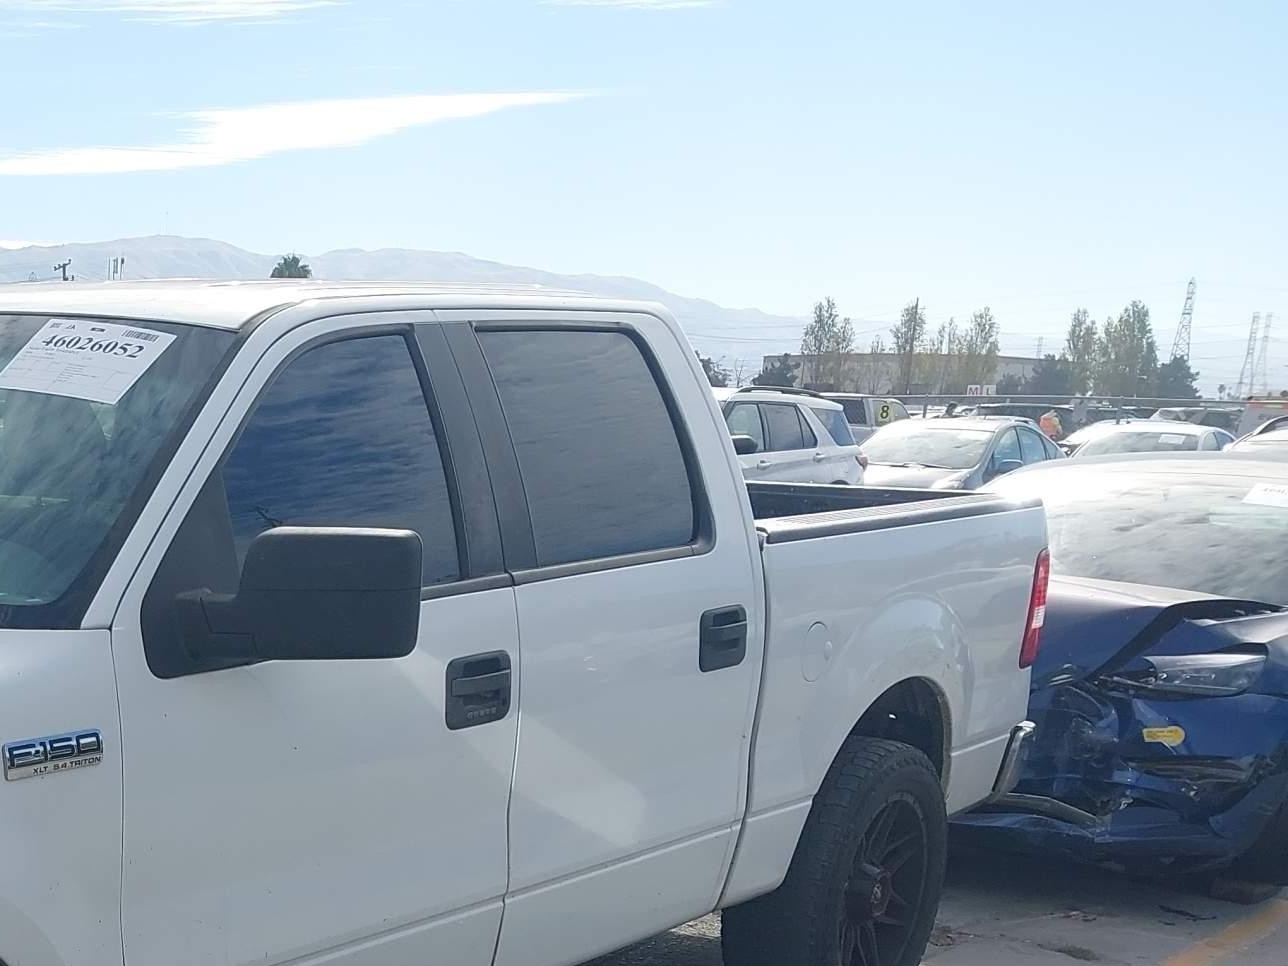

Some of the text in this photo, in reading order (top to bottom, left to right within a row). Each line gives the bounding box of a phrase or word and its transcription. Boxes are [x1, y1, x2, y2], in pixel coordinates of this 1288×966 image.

[42, 334, 145, 358] 46026052
[880, 405, 889, 419] 8
[7, 731, 101, 768] F-150
[32, 765, 49, 775] XLT
[68, 755, 102, 769] TRITON
